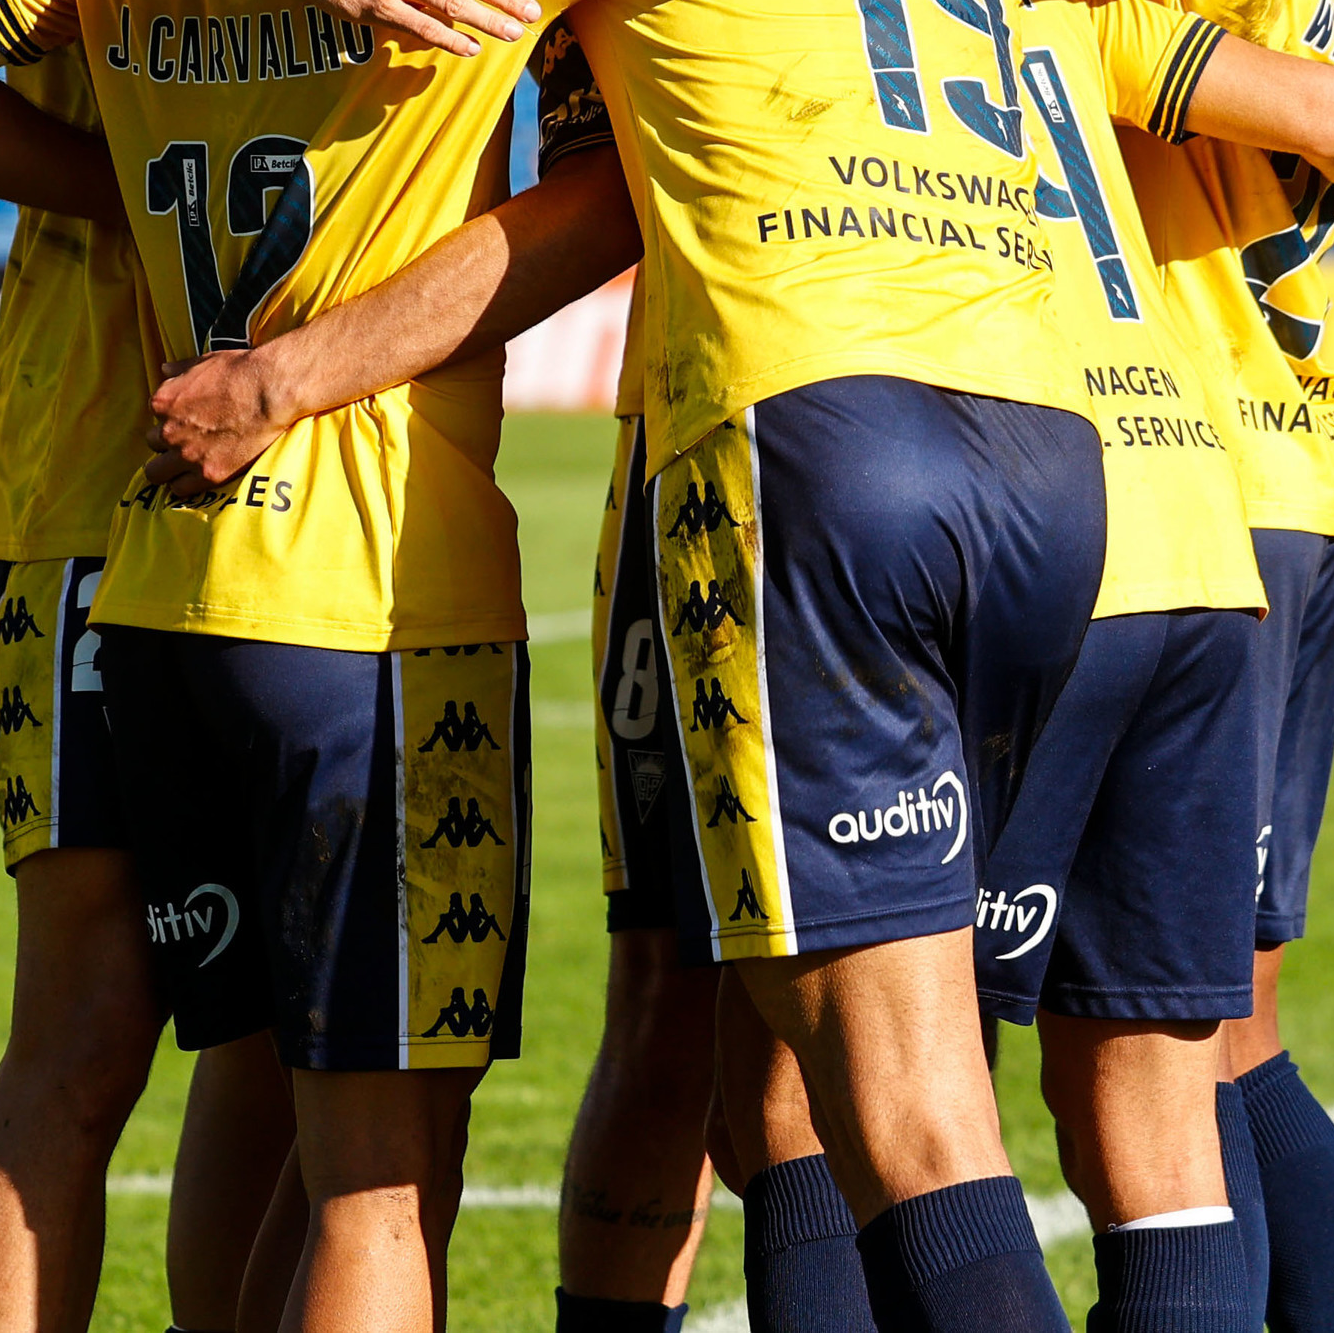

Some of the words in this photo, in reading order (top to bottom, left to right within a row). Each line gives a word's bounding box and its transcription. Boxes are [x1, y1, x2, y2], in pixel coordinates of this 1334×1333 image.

[107, 5, 140, 75] J.
[148, 5, 374, 83] CARVALHO
[757, 207, 986, 250] FINANCIAL
[828, 787, 955, 844] auditiv
